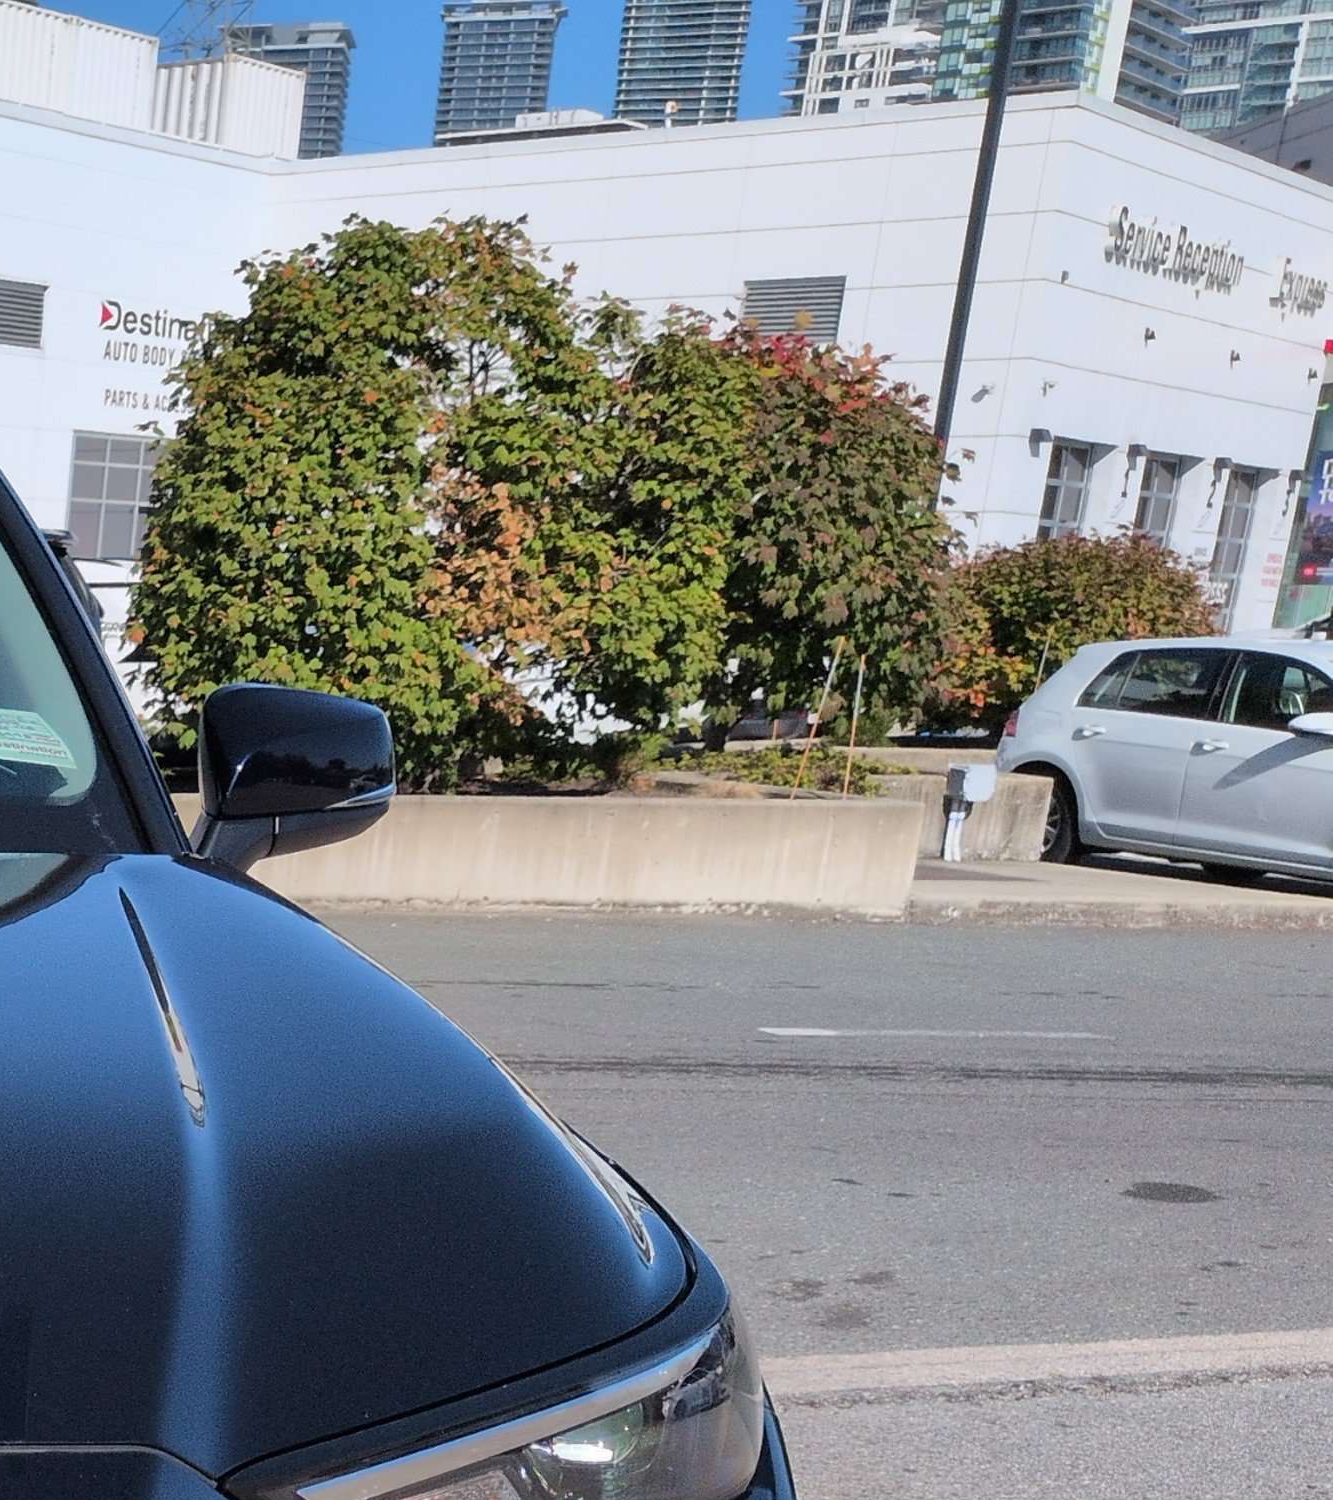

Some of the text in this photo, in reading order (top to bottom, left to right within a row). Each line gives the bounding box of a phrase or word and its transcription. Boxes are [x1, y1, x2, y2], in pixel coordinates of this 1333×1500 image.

[1114, 205, 1171, 266] Service
[1172, 224, 1244, 289] Reception
[99, 299, 214, 342] Destina
[103, 340, 138, 363] AUTO
[141, 344, 175, 367] BODY
[103, 388, 138, 409] PARTS
[141, 393, 150, 410] &
